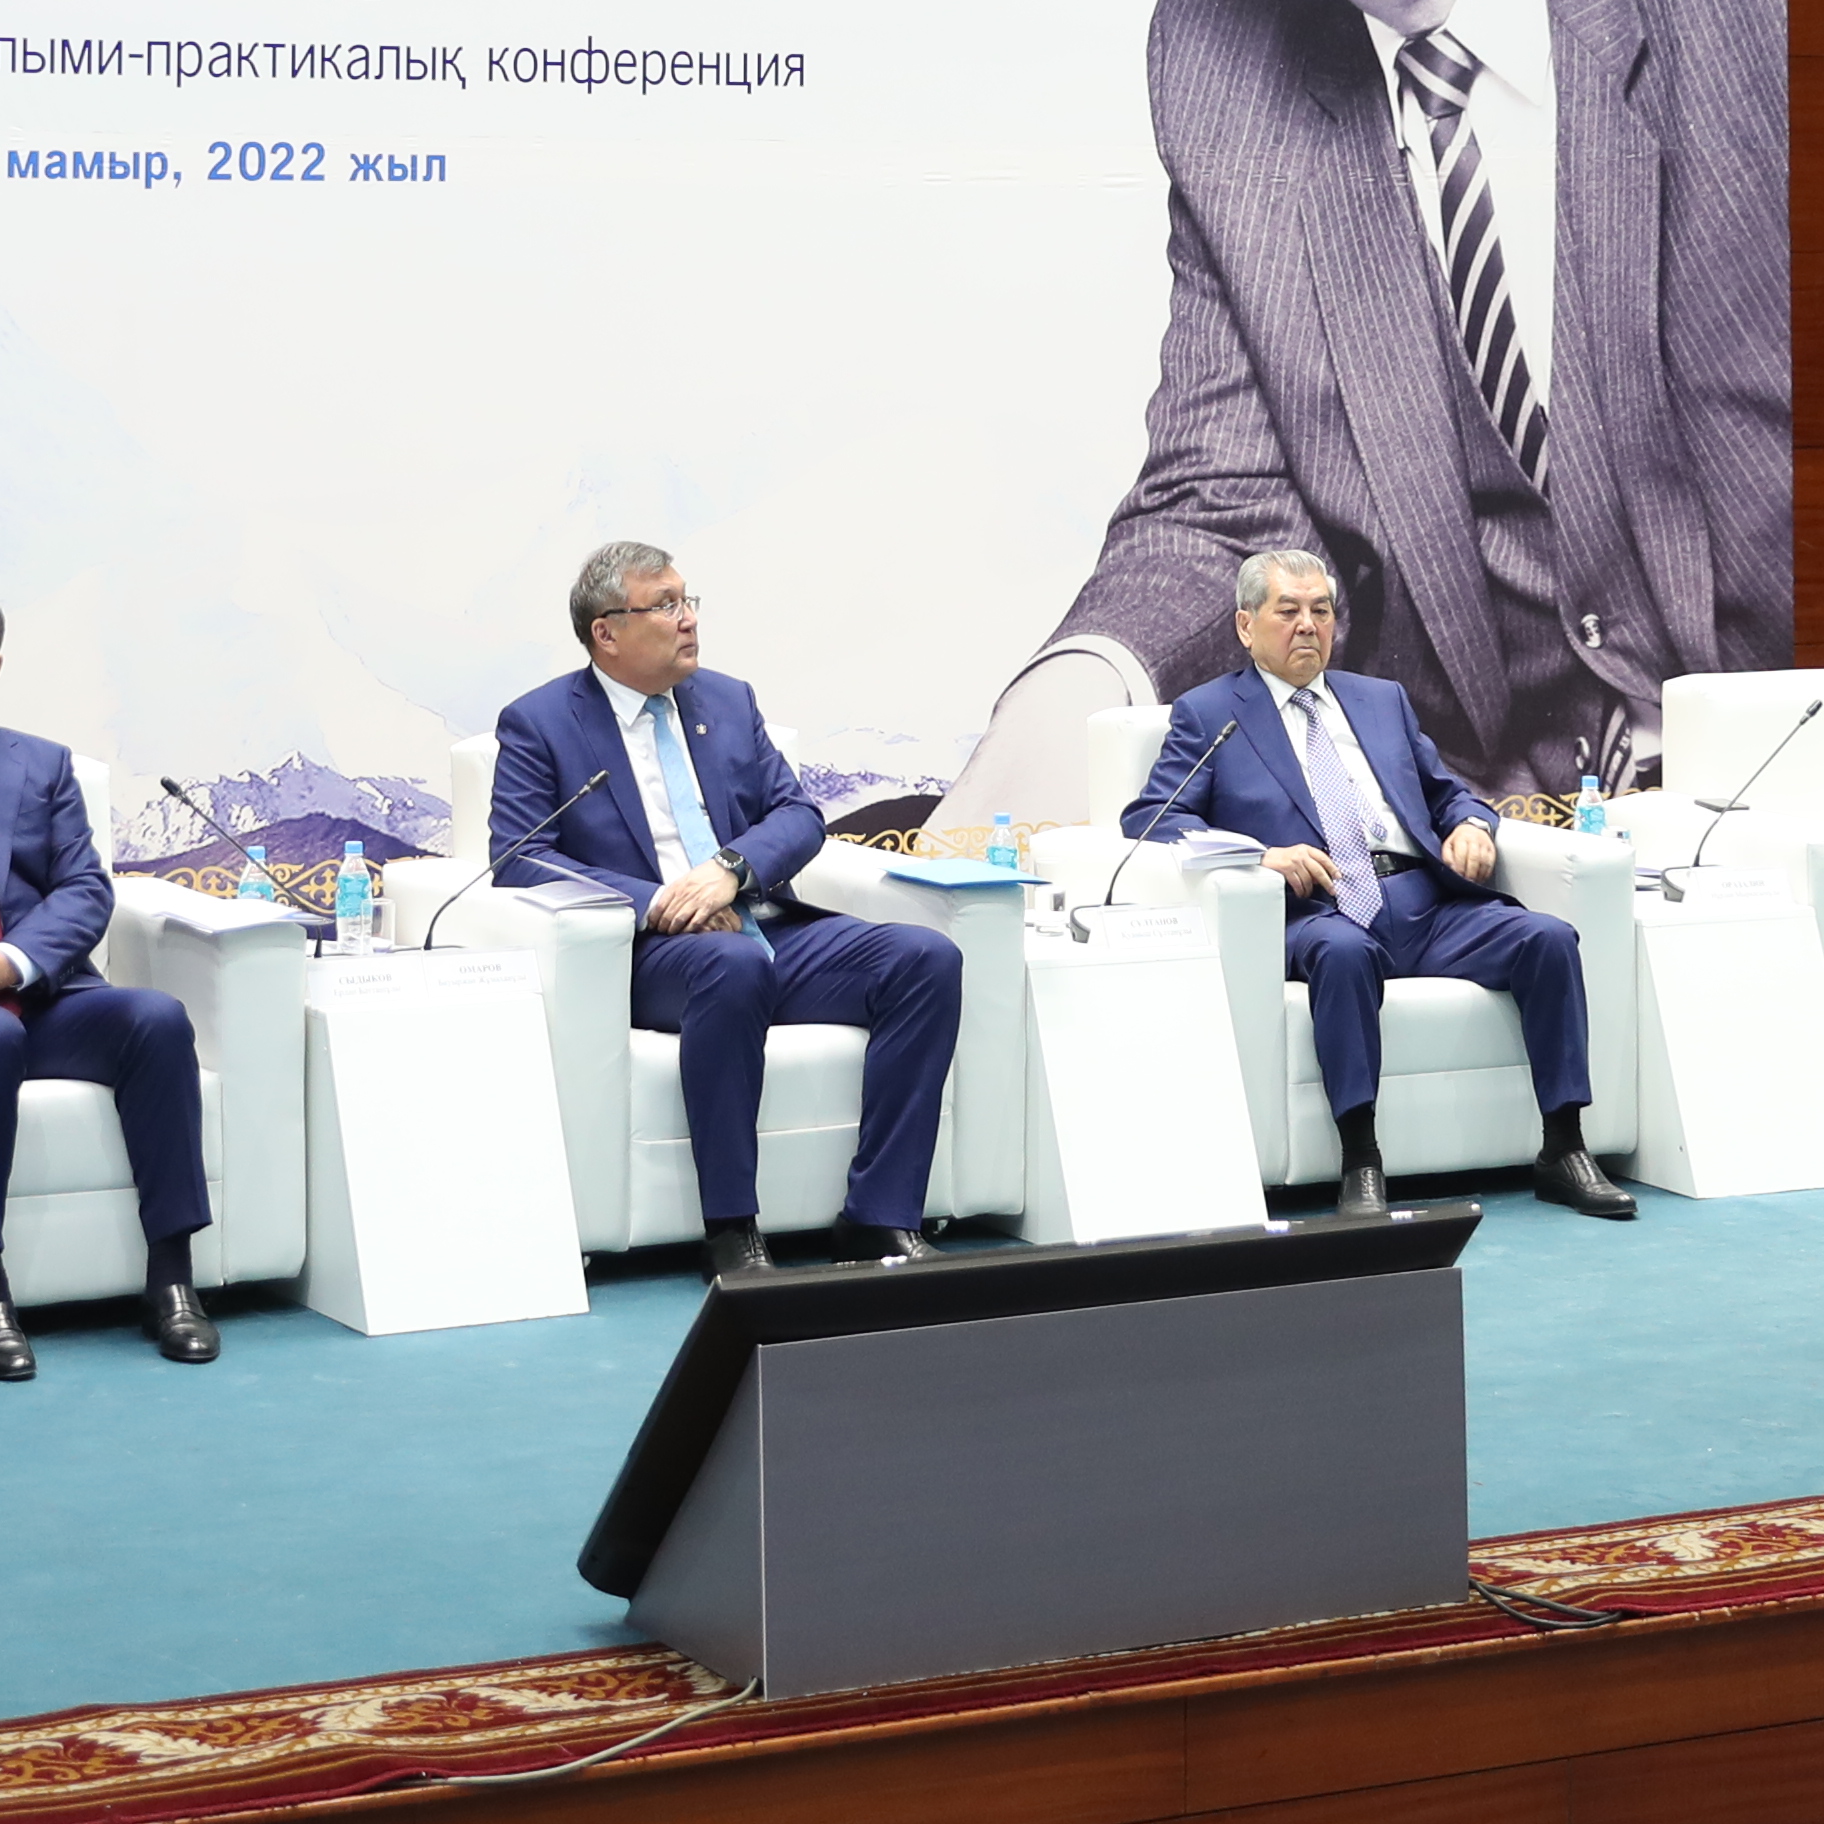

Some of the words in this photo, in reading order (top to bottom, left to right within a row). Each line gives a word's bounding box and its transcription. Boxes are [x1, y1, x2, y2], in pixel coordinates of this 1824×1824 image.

[489, 36, 804, 95] конференция
[8, 148, 183, 189] мамыр,
[208, 141, 325, 181] 2022
[348, 150, 447, 183] жыл
[458, 963, 503, 974] ОМАРОВ
